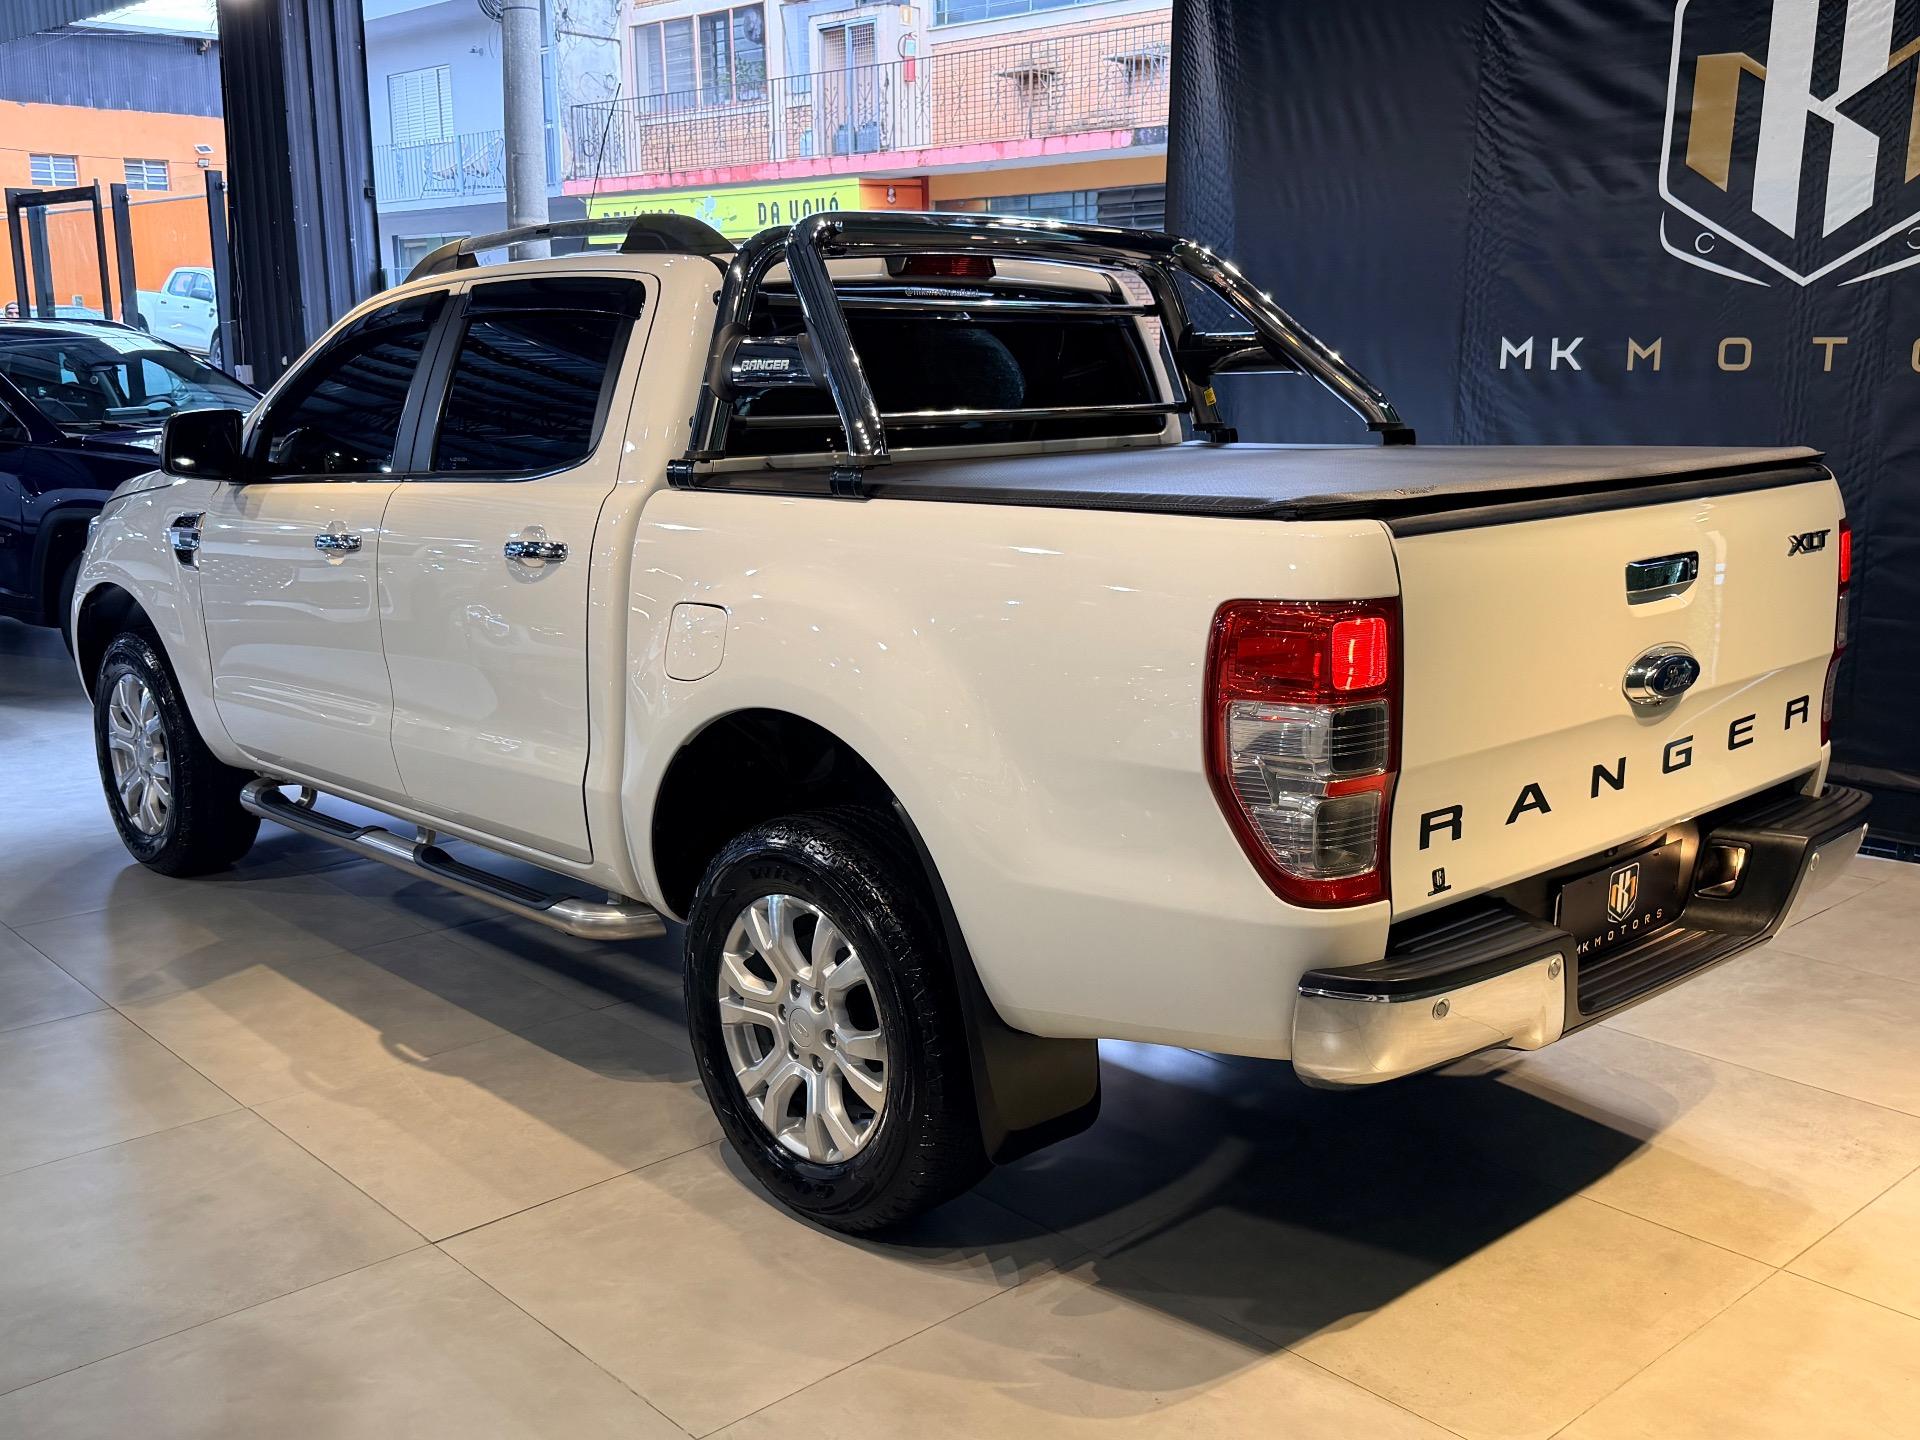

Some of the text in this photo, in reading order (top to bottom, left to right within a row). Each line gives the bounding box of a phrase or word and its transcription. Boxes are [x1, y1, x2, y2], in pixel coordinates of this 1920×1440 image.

[758, 202, 780, 225] DA
[741, 359, 789, 371] RANGER
[1627, 336, 1920, 373] MOT
[1787, 529, 1831, 557] XLT
[1419, 695, 1810, 850] RANGER
[1594, 908, 1663, 947] MOTORS
